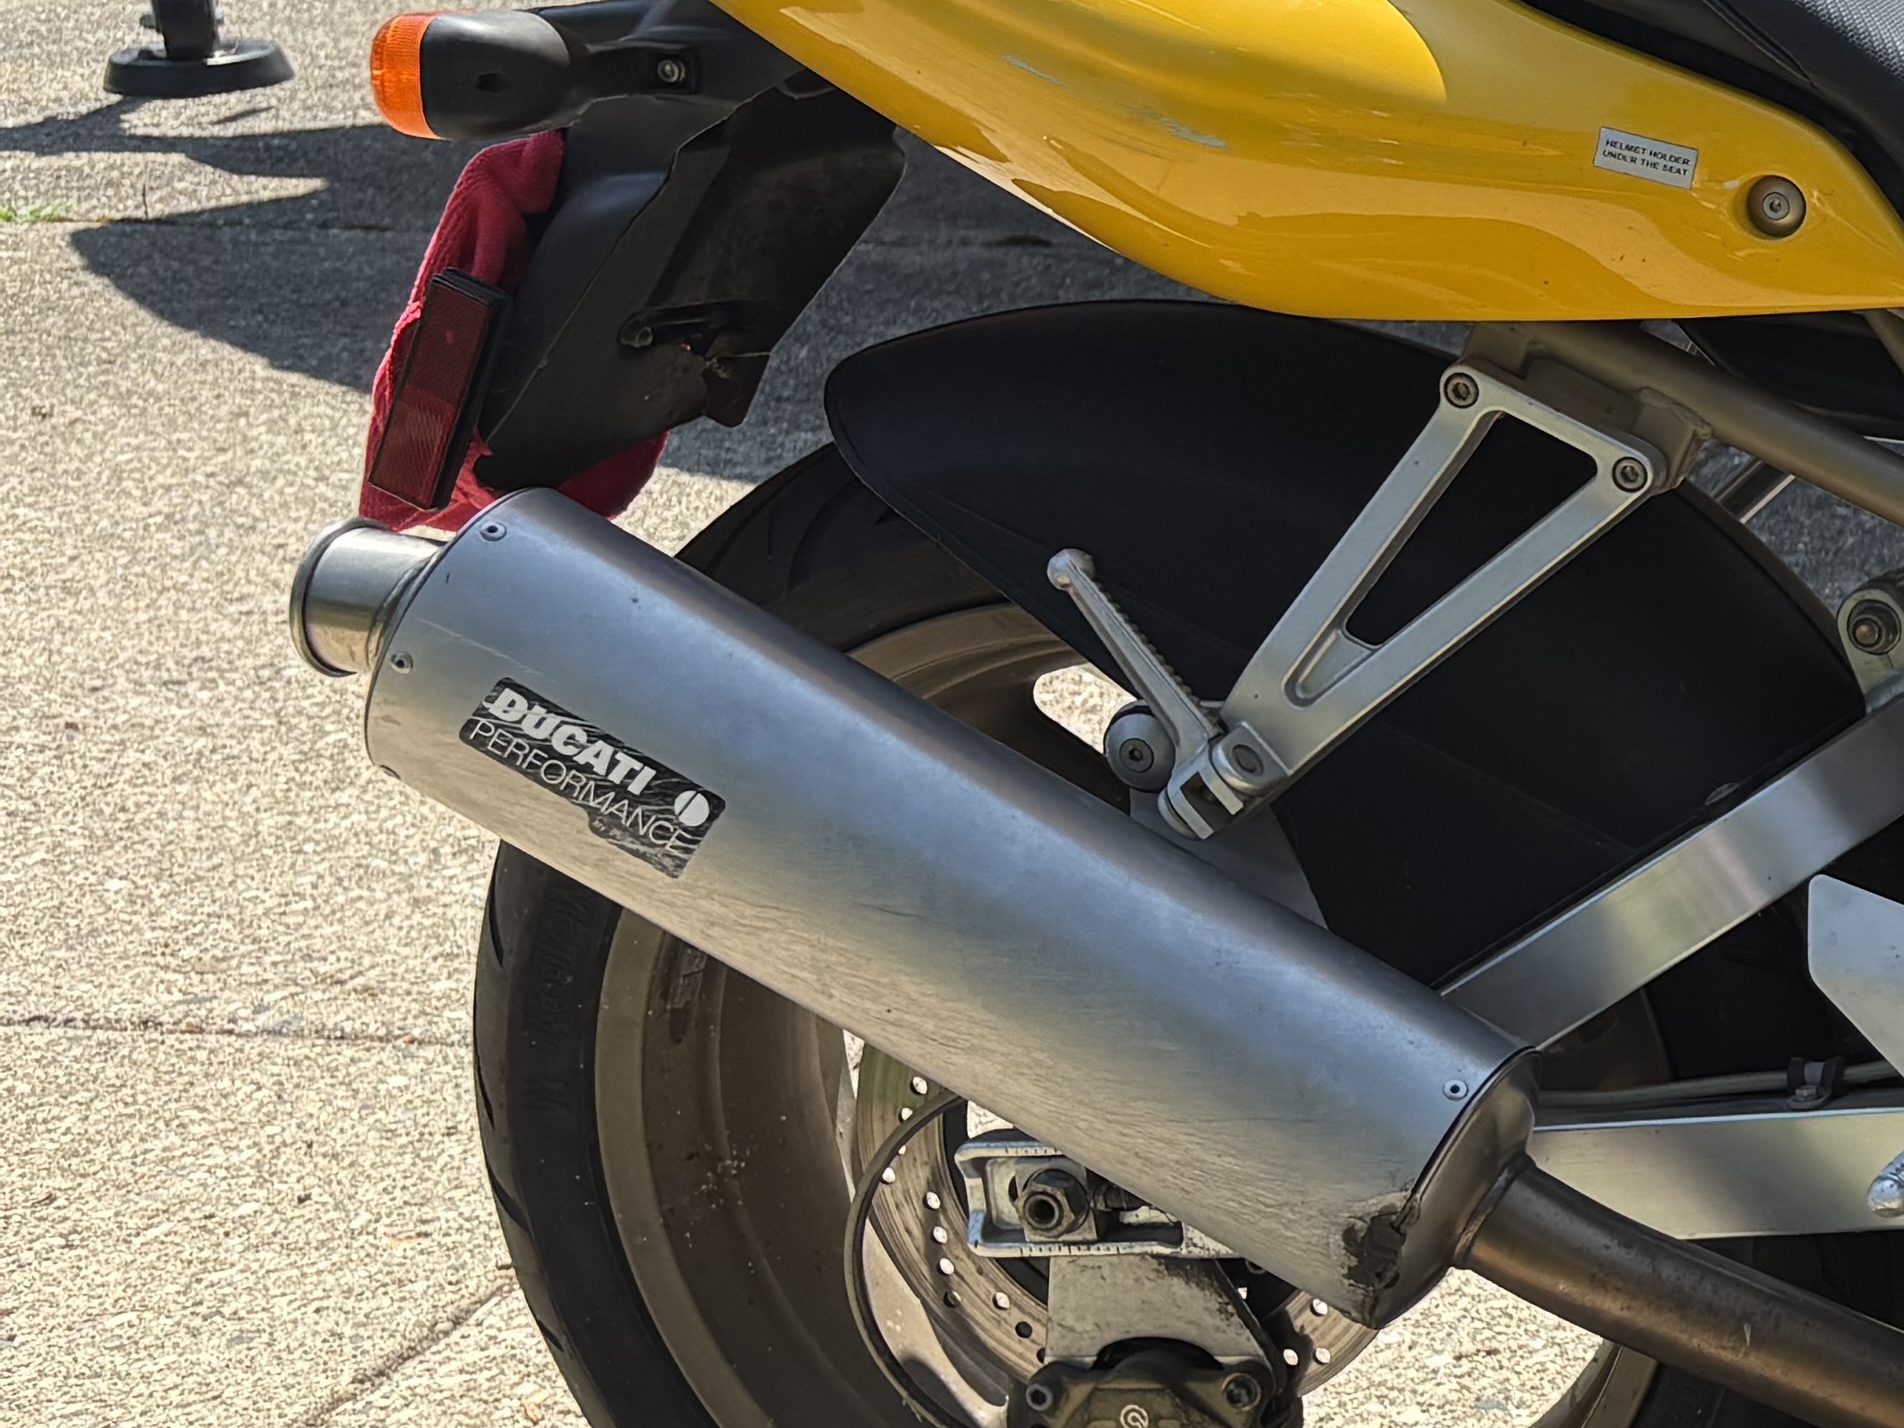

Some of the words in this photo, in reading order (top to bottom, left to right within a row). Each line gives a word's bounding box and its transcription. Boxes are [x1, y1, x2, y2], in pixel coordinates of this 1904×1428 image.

[1602, 149, 1637, 165] UNDER
[1640, 159, 1659, 171] THE
[1662, 162, 1688, 176] SEAT
[1605, 139, 1647, 155] HELMET
[1649, 149, 1691, 167] HOLDER
[487, 688, 657, 796] DUCATI
[469, 719, 695, 853] PERFORMANCE
